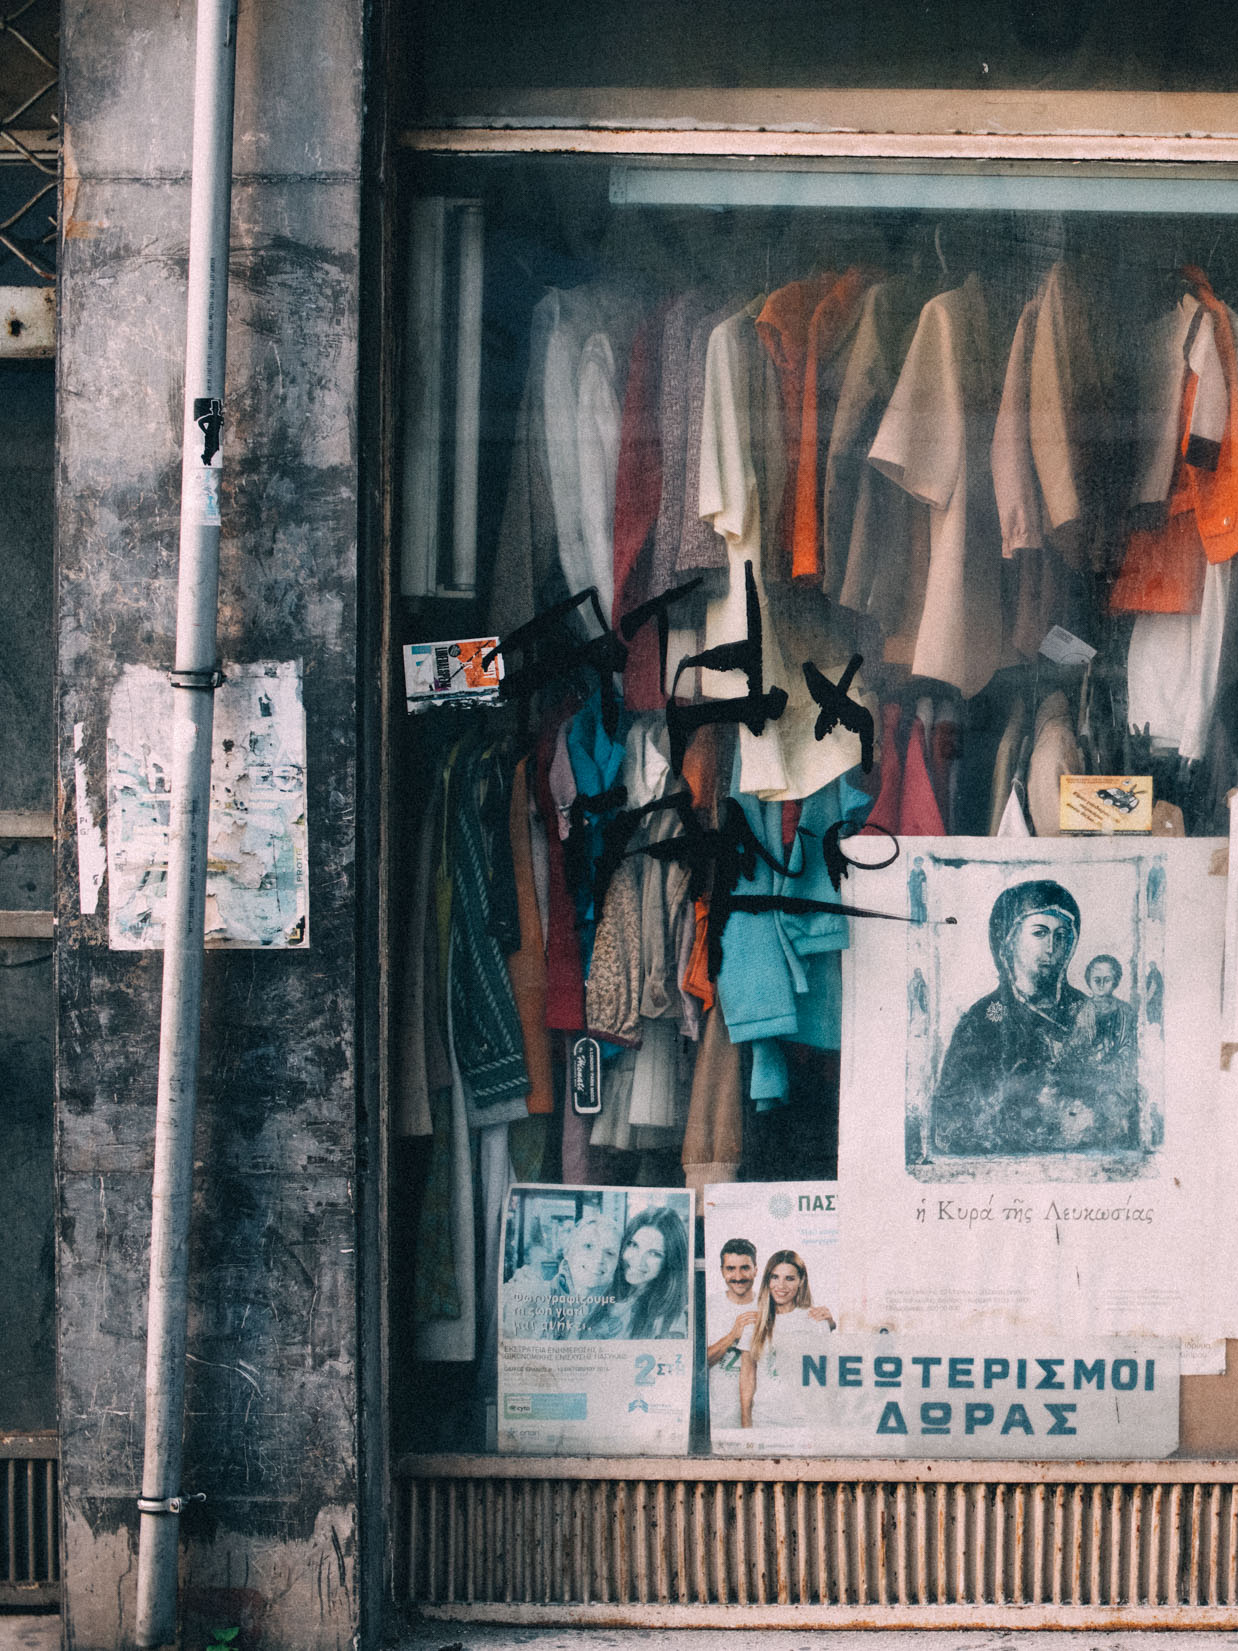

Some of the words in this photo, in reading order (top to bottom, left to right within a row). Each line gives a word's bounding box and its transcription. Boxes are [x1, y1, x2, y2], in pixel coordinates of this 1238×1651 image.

[798, 1194, 838, 1212] ΠΑΣ
[937, 1194, 995, 1229] Κυρά
[1043, 1194, 1154, 1225] Λευκωσίας
[802, 1355, 1155, 1391] ΝΕΩΤΕΡΙΣΜΟΙ
[876, 1402, 1077, 1435] ΔΩΡΑΣ
